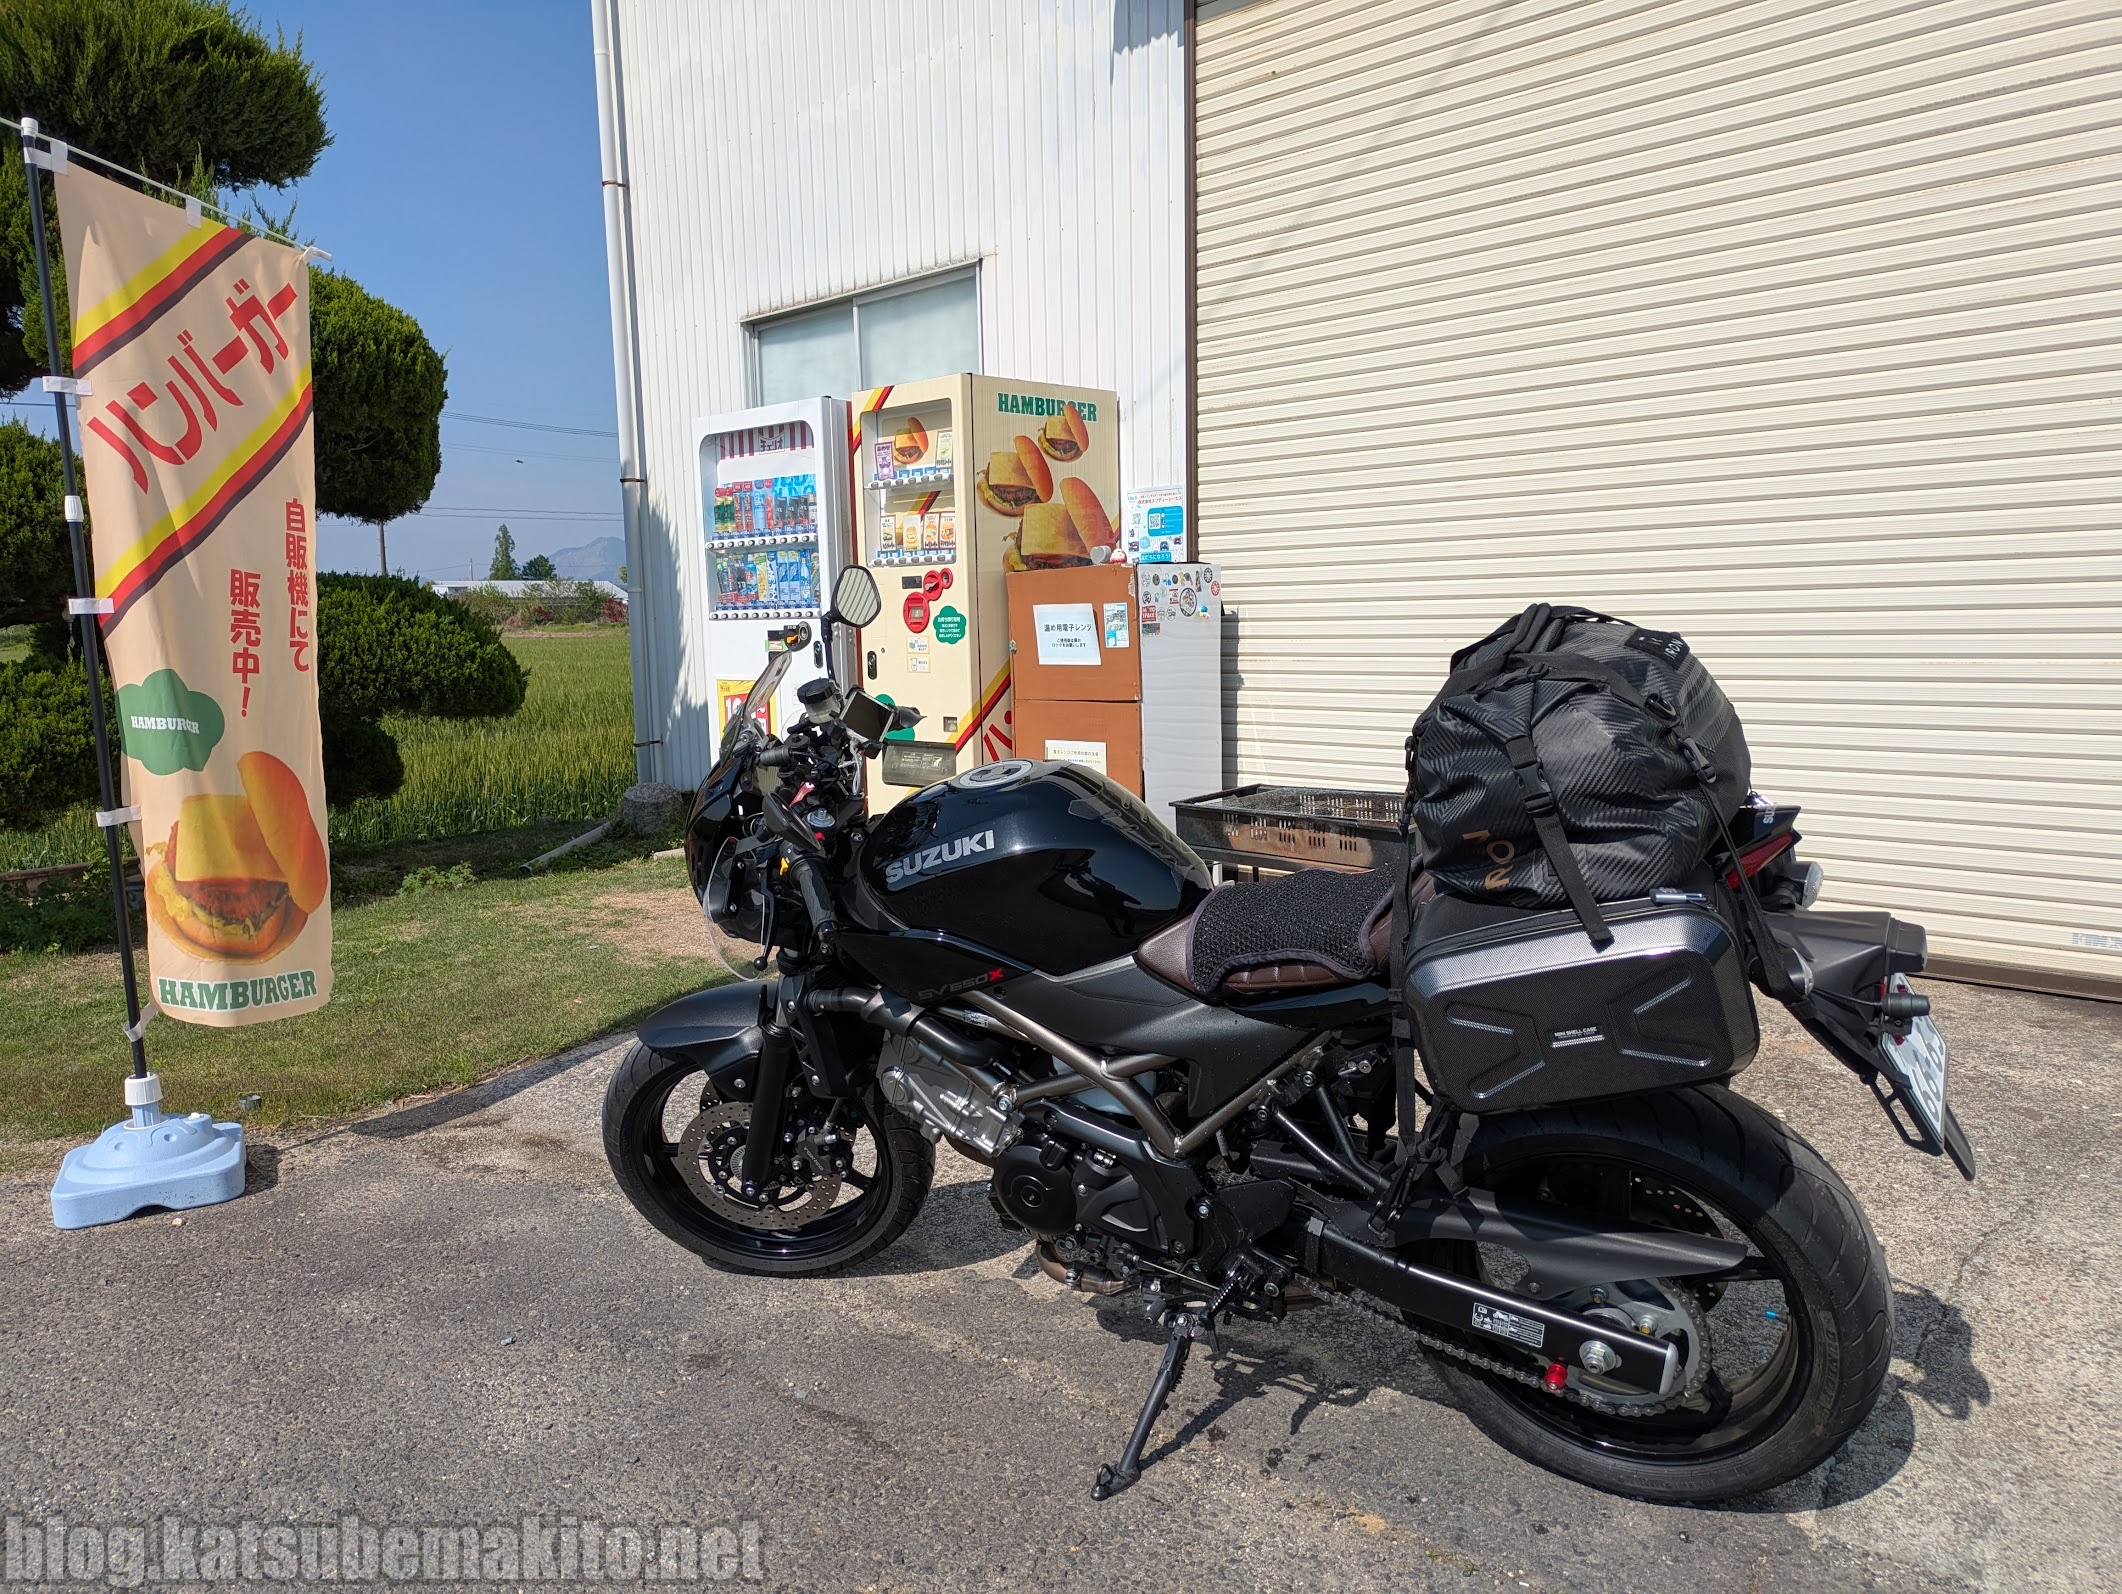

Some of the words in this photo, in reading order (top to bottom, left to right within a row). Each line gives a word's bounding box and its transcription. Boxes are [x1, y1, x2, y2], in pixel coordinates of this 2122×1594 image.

[87, 278, 298, 495] ハンバーガー
[285, 498, 310, 673] 自販機にて
[230, 568, 262, 718] 販売中!
[1043, 623, 1093, 632] 温め用電子レンジ
[1663, 637, 1684, 660] IRON
[131, 715, 200, 735] HAMBURGER
[885, 829, 995, 884] SUZUKI
[158, 968, 319, 1012] HAMBURGER
[917, 967, 1005, 1002] SV650X
